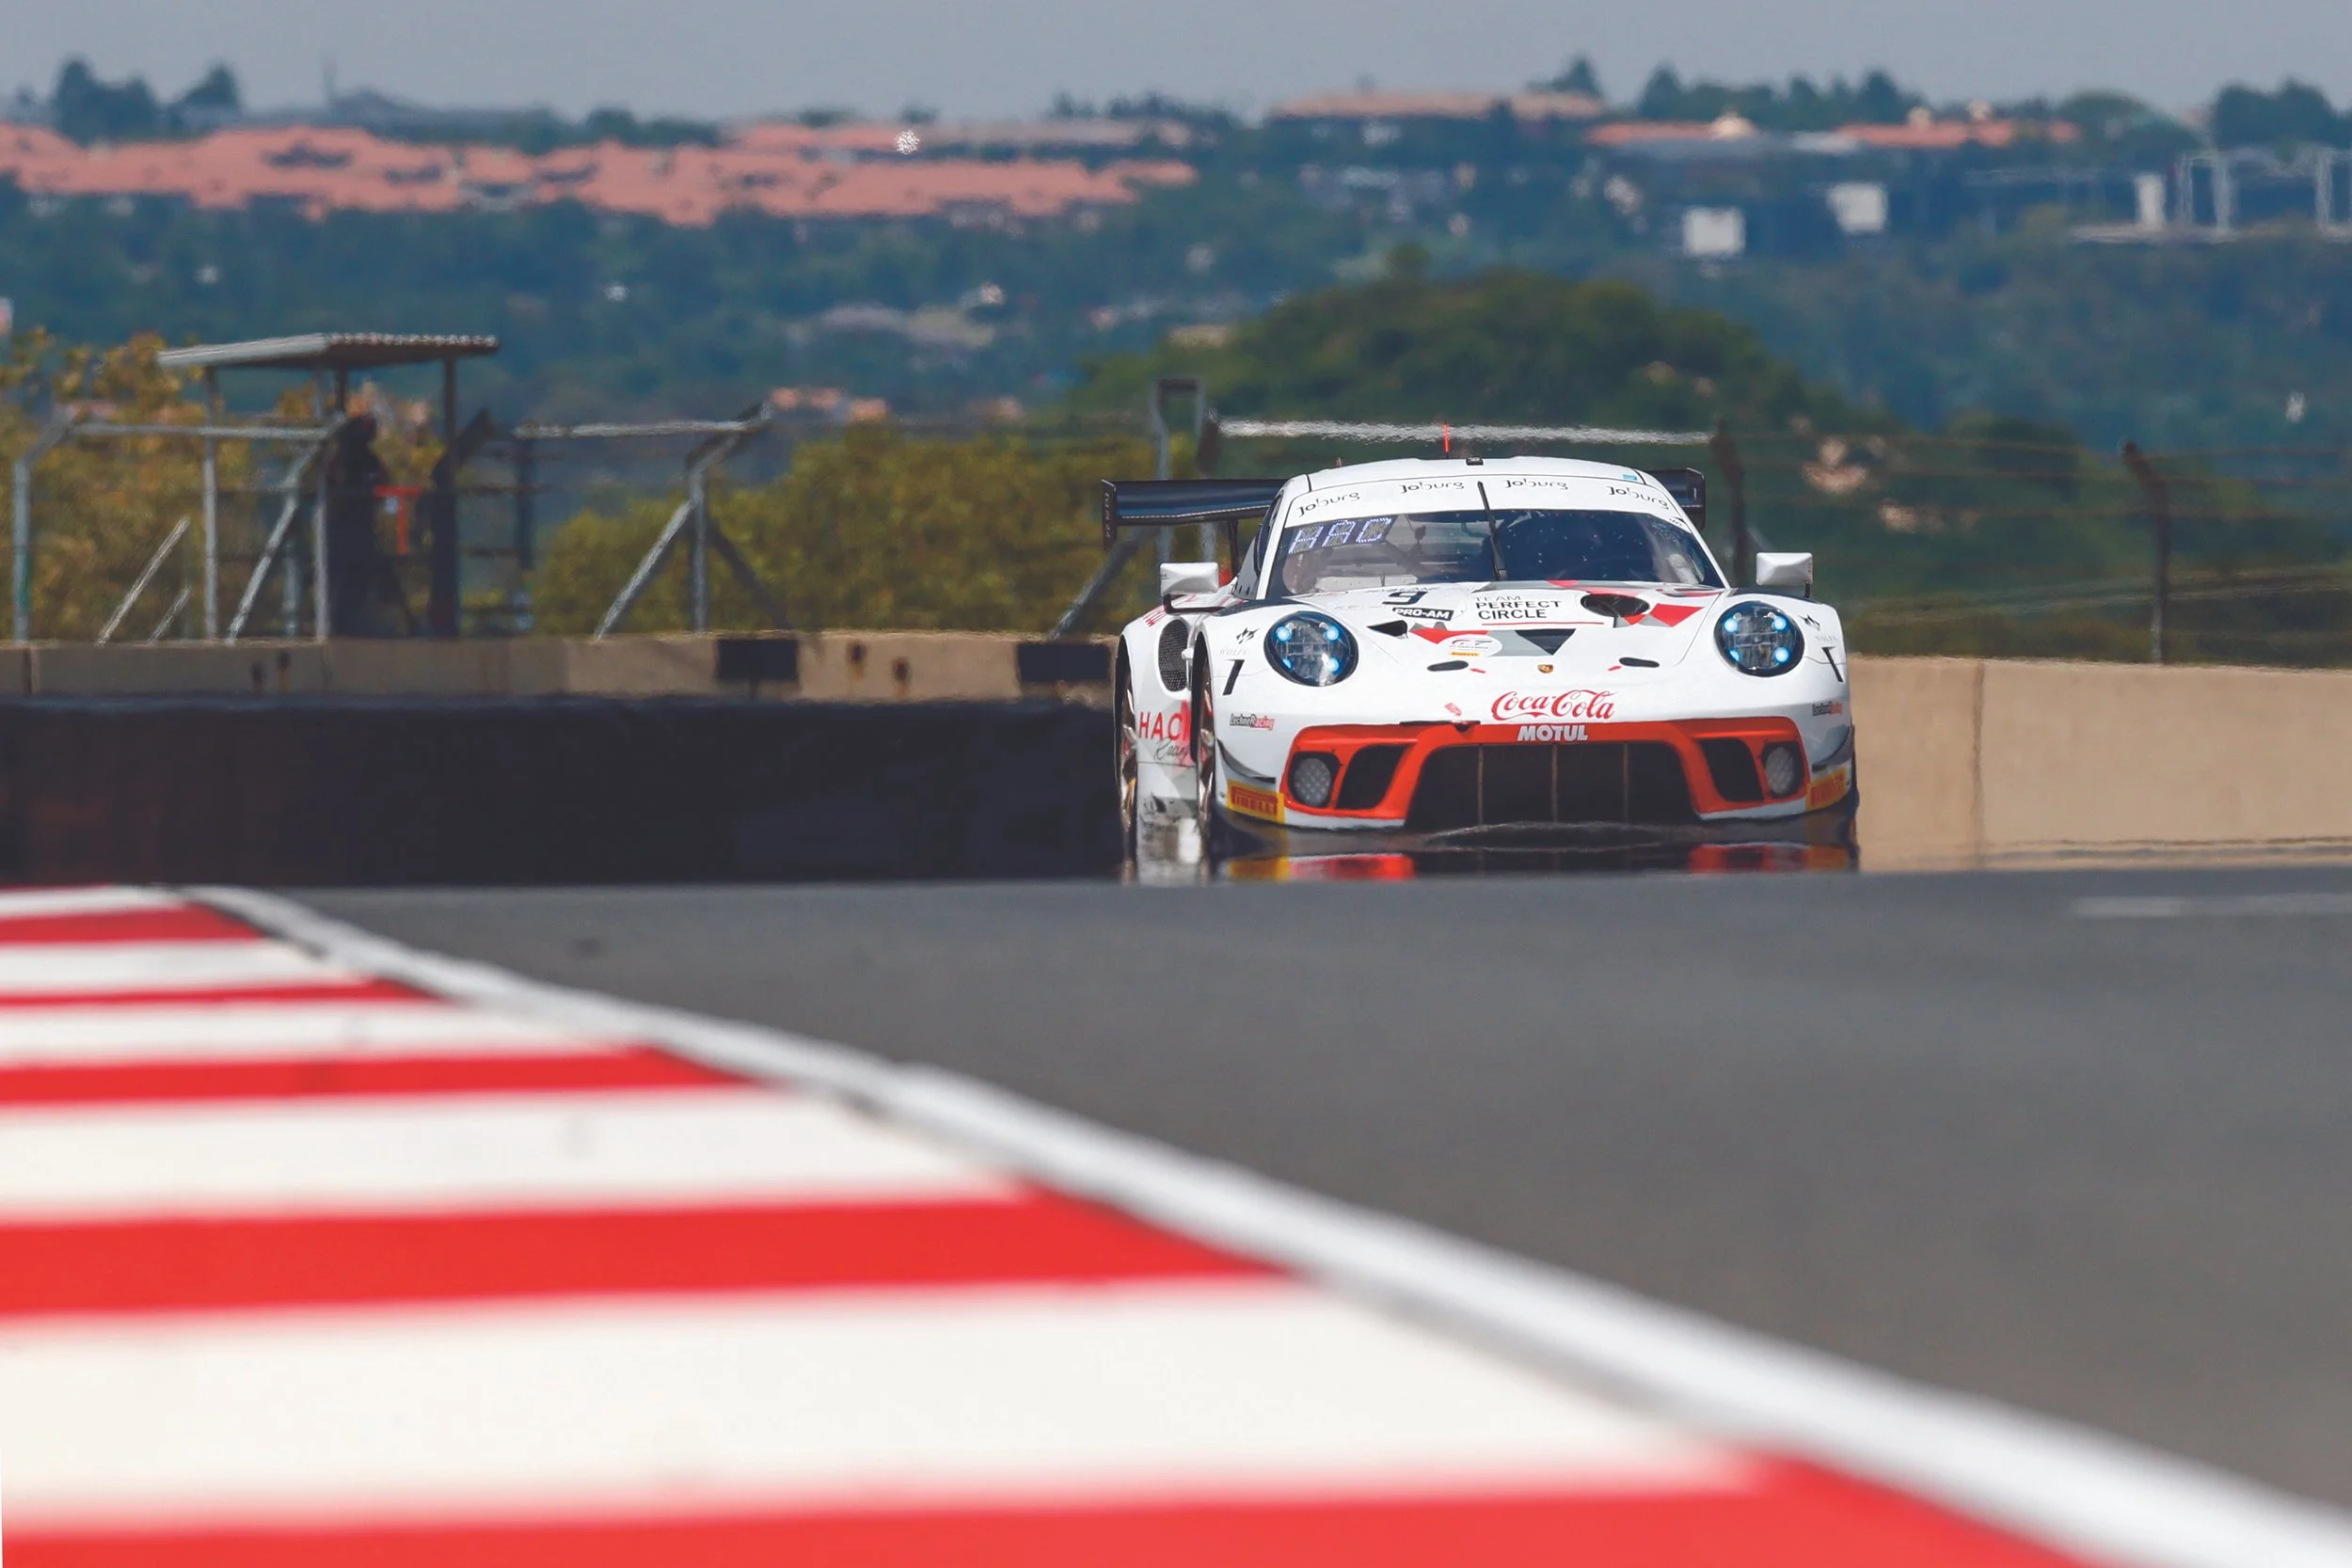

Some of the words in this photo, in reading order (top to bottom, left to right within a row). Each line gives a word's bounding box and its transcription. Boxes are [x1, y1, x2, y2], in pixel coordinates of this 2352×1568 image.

[1399, 481, 1465, 494] Joburg
[1505, 478, 1568, 490] Joburg
[1296, 492, 1361, 517] Joburg
[1608, 485, 1670, 511] Joburg
[1288, 517, 1392, 554] HAC
[1475, 600, 1562, 610] PERFECT
[1394, 608, 1451, 619] PRO-AM
[1478, 610, 1548, 619] CIRCLE
[1491, 689, 1617, 721] Coca-Cola
[1518, 724, 1588, 741] MOTUL
